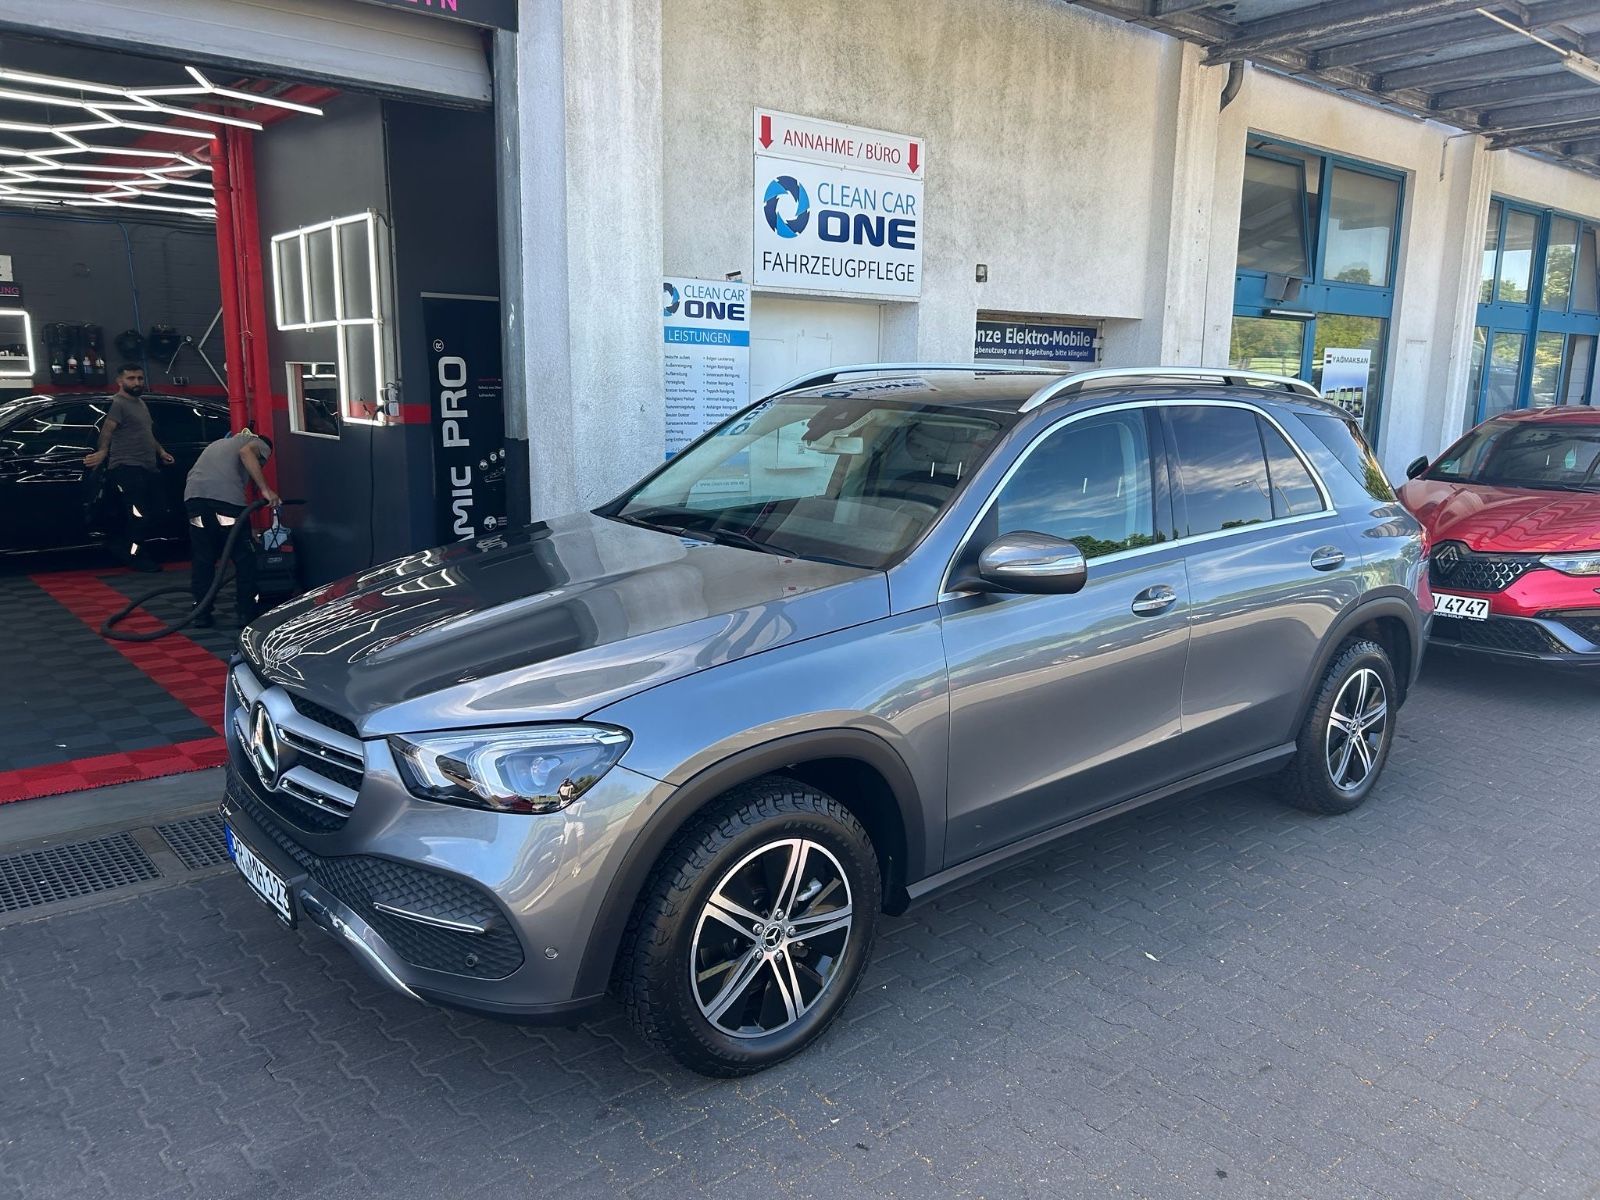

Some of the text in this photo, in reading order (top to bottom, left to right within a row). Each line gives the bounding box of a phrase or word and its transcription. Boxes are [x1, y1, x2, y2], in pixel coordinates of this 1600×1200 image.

[783, 129, 901, 164] ANNAHME / BÜRO
[817, 182, 916, 216] CLEAN CAR
[818, 210, 916, 250] ONE
[762, 251, 914, 282] FAHRZEUGPFLEGE
[684, 284, 744, 301] CLEAN CAR
[684, 300, 744, 321] ONE
[668, 330, 730, 344] LEISTUNGEN
[975, 329, 1001, 343] nze
[1445, 598, 1486, 616] 4747
[266, 870, 290, 913] 123
